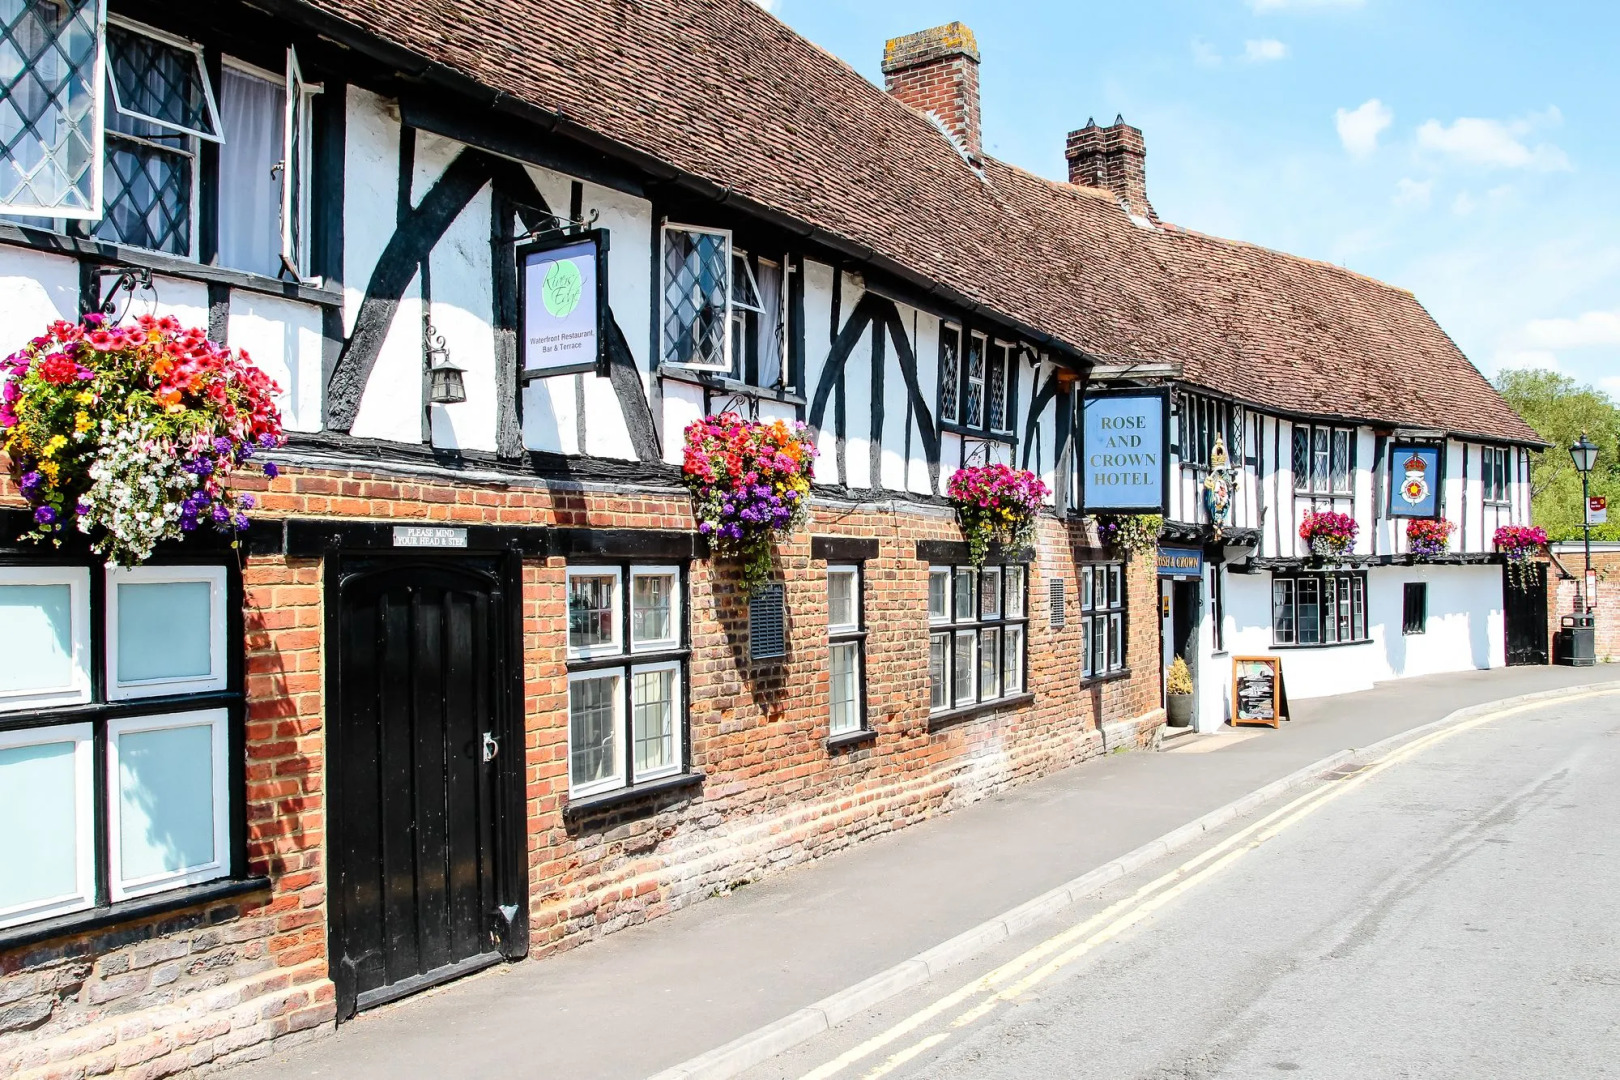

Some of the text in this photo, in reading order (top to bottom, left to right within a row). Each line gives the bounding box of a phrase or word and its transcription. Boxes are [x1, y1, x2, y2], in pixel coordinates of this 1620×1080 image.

[530, 334, 560, 345] Waterfront
[542, 341, 582, 353] Bar & Terrace
[1101, 415, 1146, 430] ROSE
[1106, 434, 1142, 448] AND
[1090, 453, 1157, 468] CROWN
[1094, 472, 1154, 486] HOTEL
[408, 528, 455, 538] PLEASE MIND
[399, 536, 464, 546] YOUR HEAD & STEP
[1158, 555, 1199, 569] OSE & CROWN
